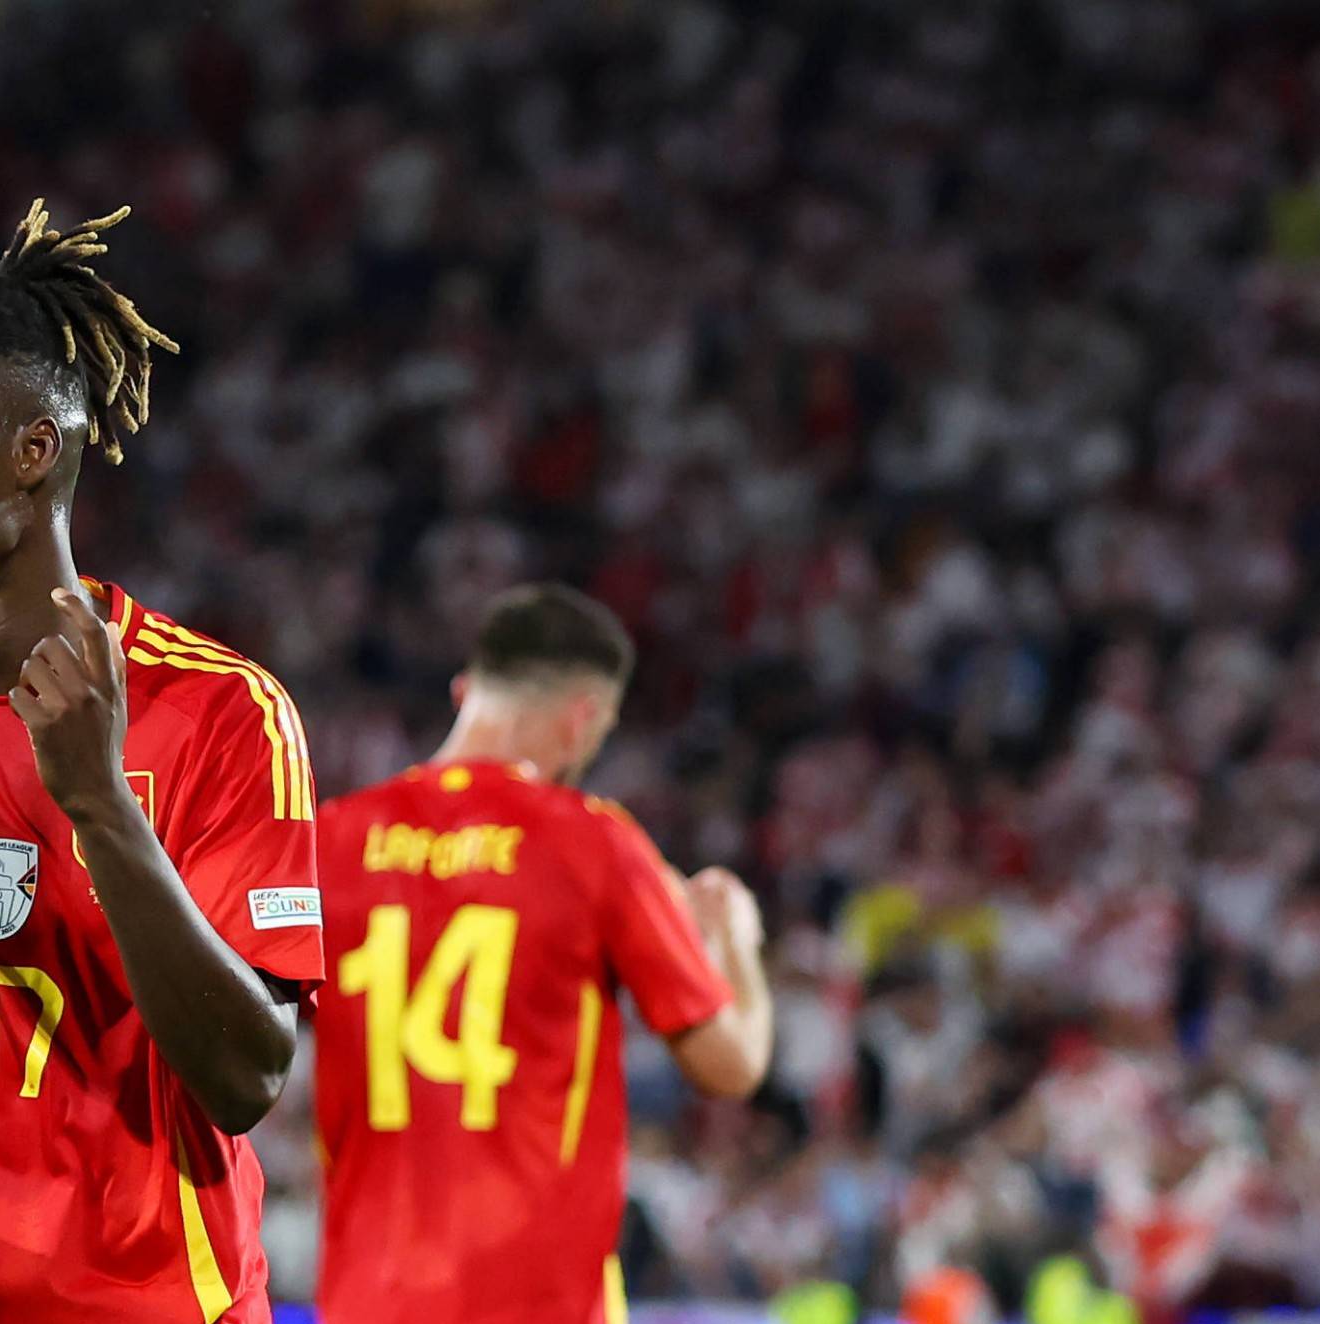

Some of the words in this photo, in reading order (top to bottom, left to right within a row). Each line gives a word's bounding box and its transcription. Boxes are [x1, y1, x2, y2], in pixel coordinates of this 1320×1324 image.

[8, 842, 34, 853] LEAGUE
[253, 891, 280, 901] UEFA
[337, 902, 519, 1133] 14
